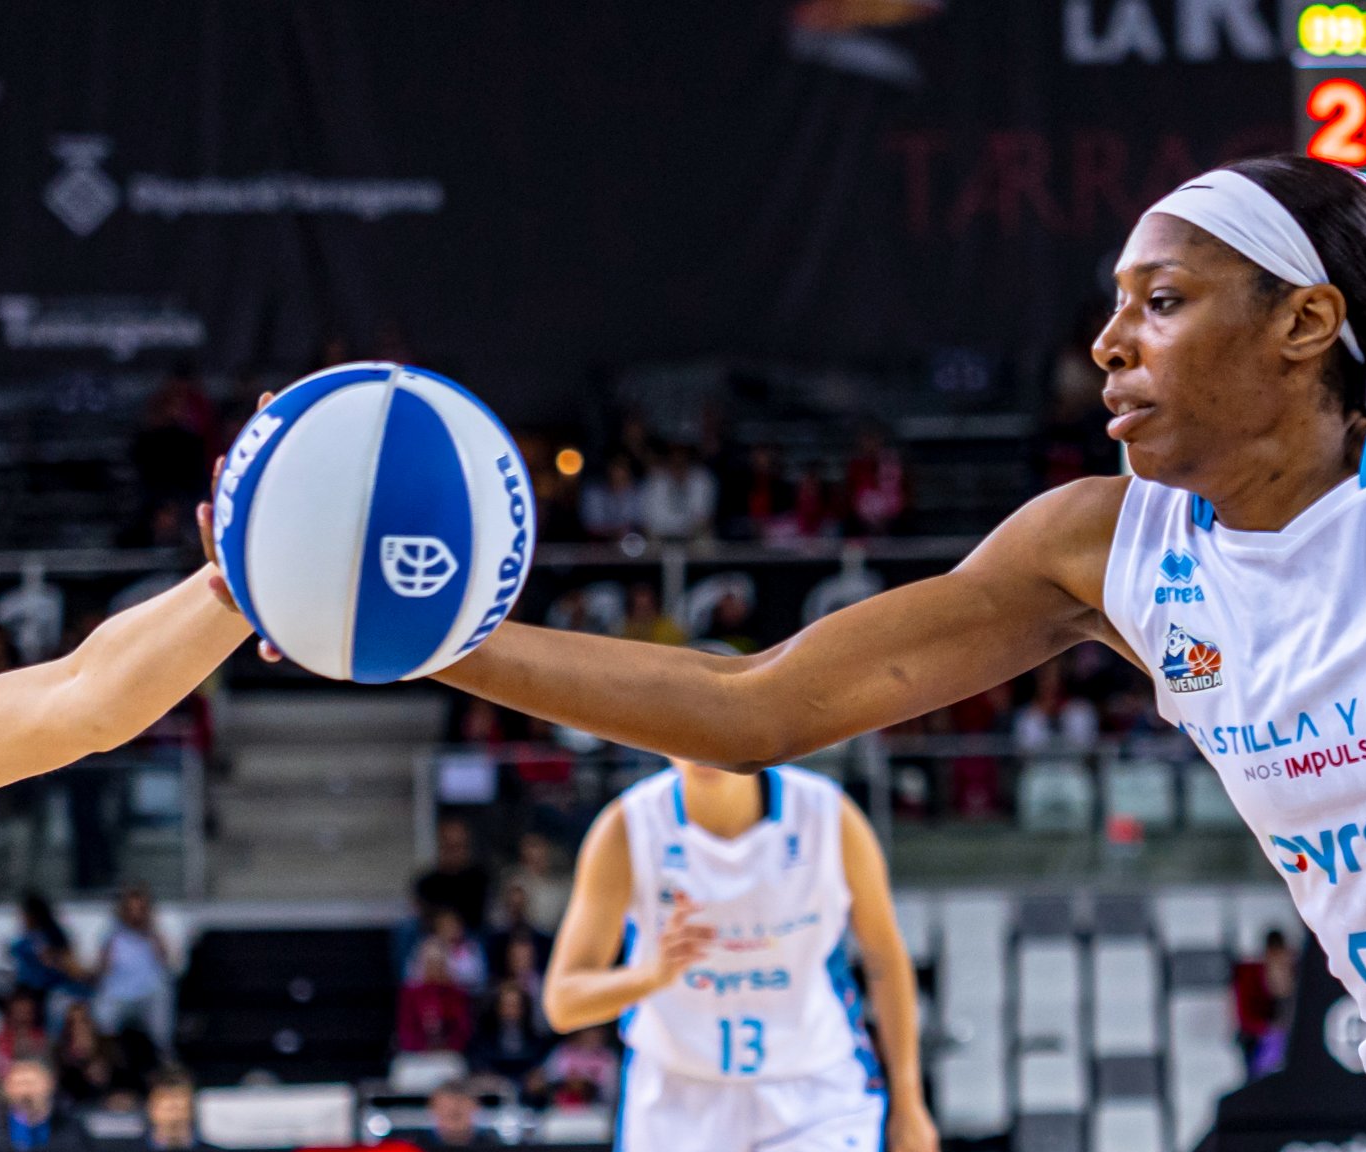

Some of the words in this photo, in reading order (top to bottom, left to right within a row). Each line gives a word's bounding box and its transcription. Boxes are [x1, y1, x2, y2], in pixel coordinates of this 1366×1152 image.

[1335, 698, 1357, 737] Y
[1243, 762, 1283, 782] NOS
[719, 1016, 766, 1075] 13
